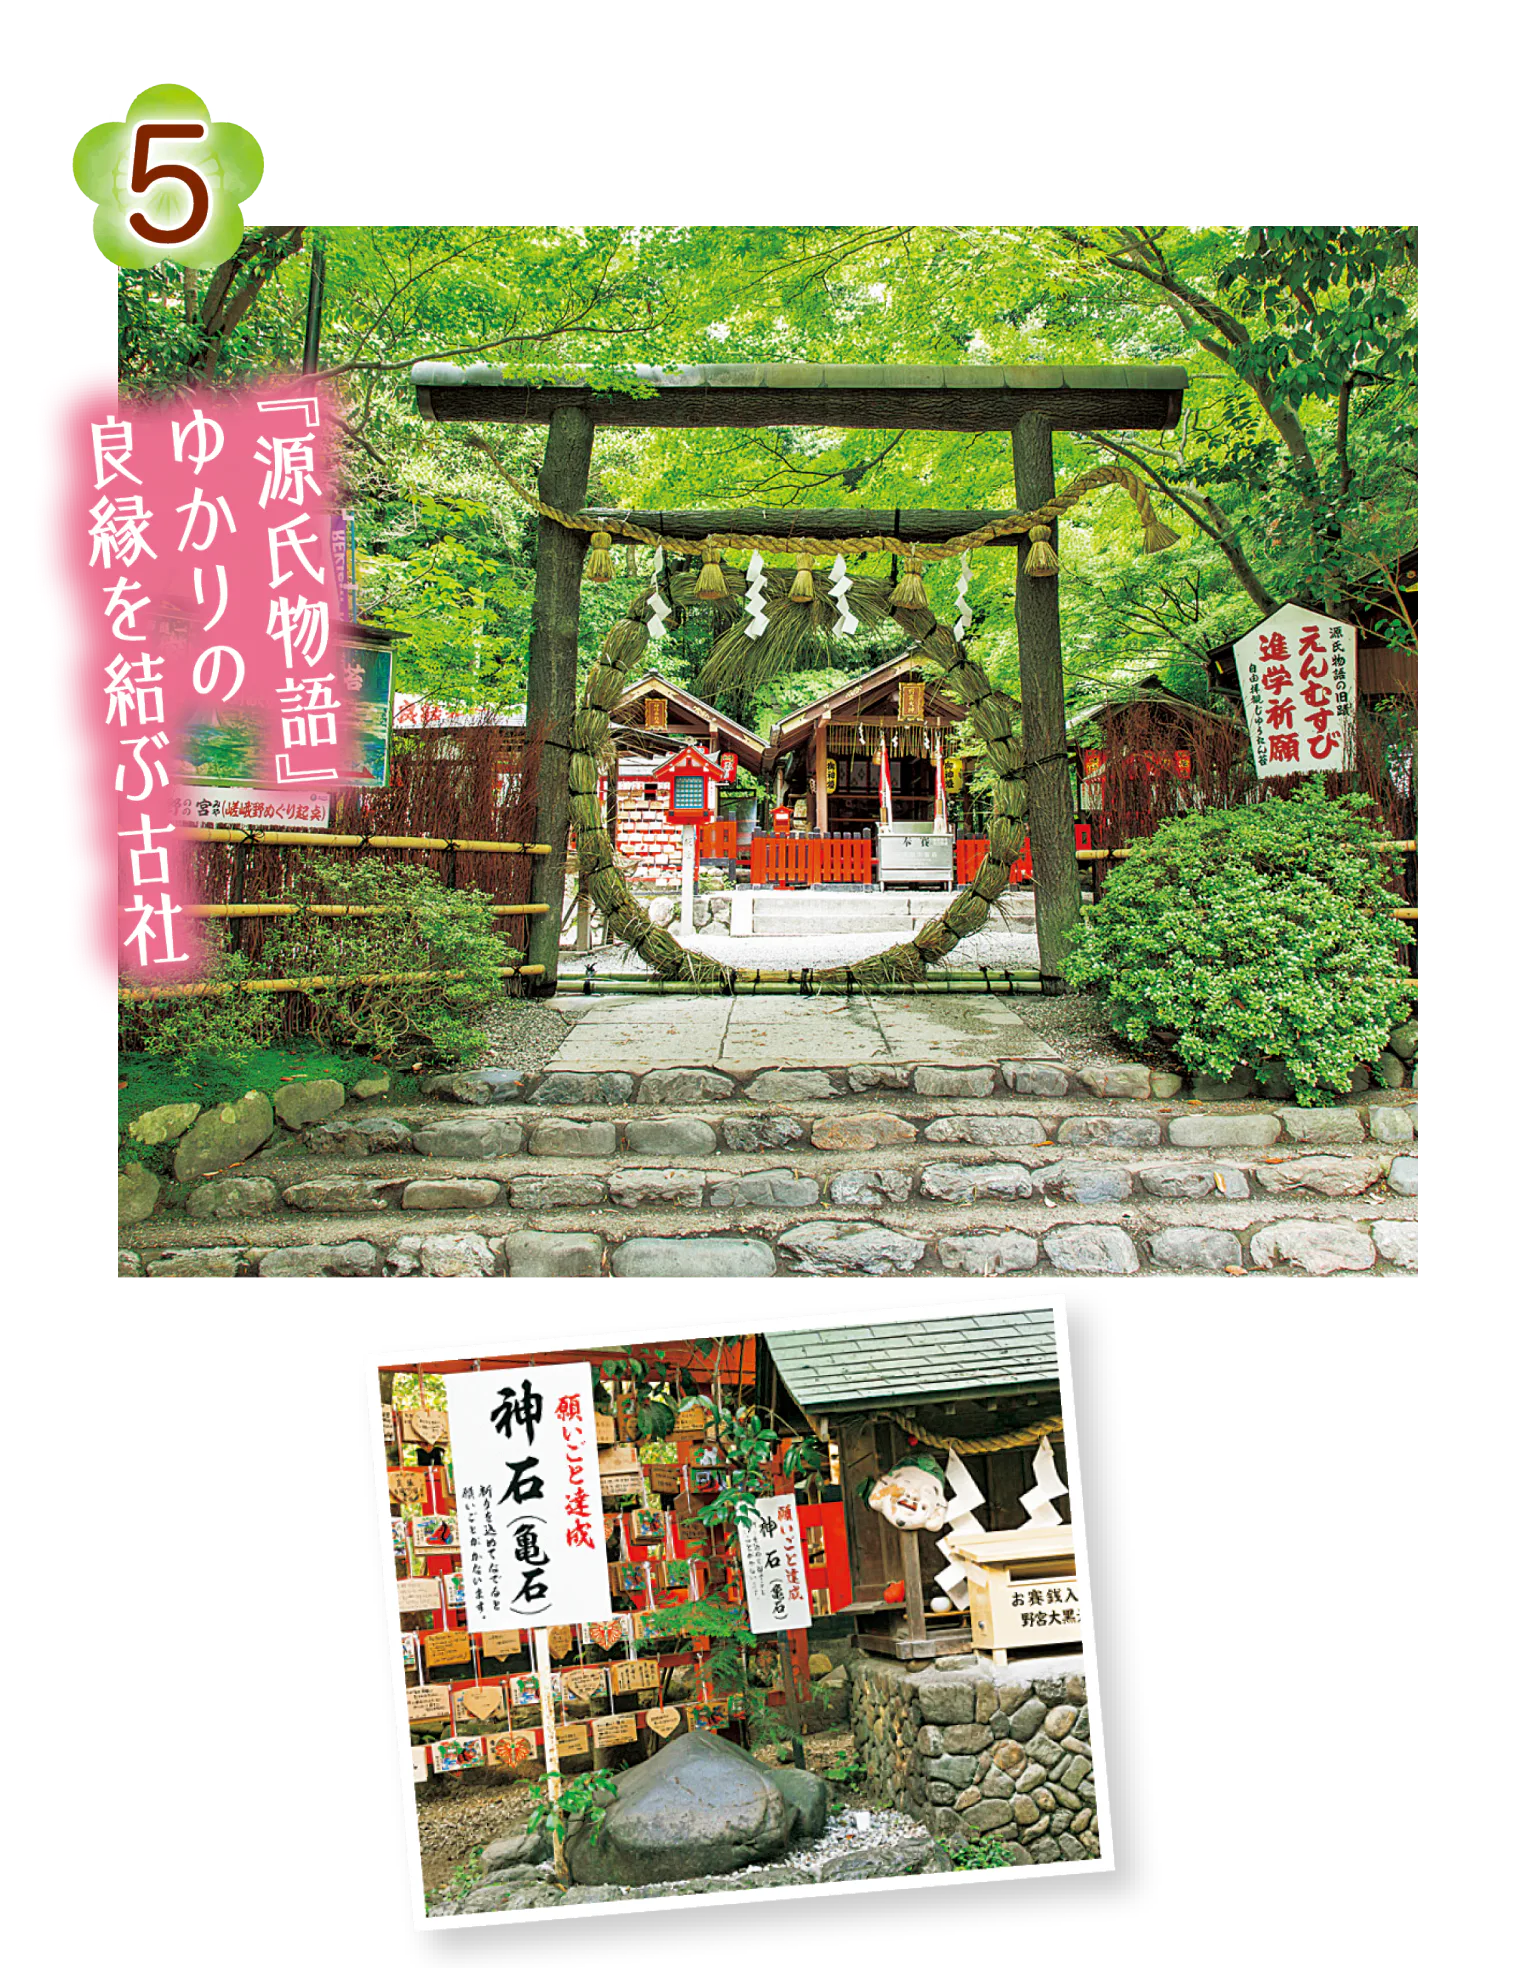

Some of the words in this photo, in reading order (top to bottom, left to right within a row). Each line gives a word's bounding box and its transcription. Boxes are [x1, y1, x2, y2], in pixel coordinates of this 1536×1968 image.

[1258, 631, 1300, 763] 進学祈願
[1298, 625, 1341, 760] えんむすび
[554, 1392, 596, 1550] 願いごと達成
[777, 1503, 804, 1601] 願いごと達成
